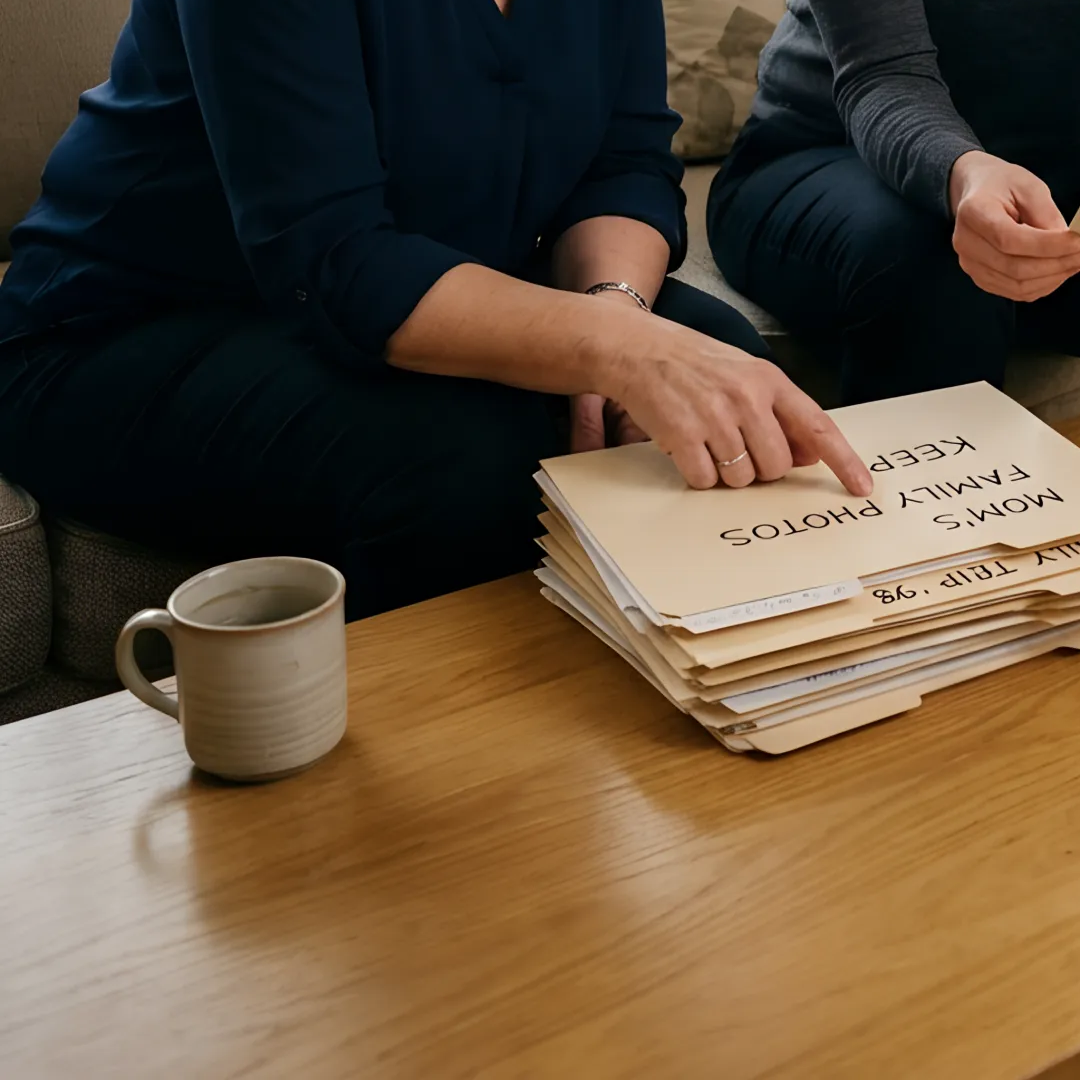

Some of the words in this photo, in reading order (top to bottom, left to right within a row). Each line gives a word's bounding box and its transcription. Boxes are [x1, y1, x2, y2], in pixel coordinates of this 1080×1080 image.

[869, 435, 977, 473] KEEP
[898, 464, 1032, 509] FAMILY
[719, 499, 884, 547] PHOTOS
[932, 487, 1064, 531] MOM'S
